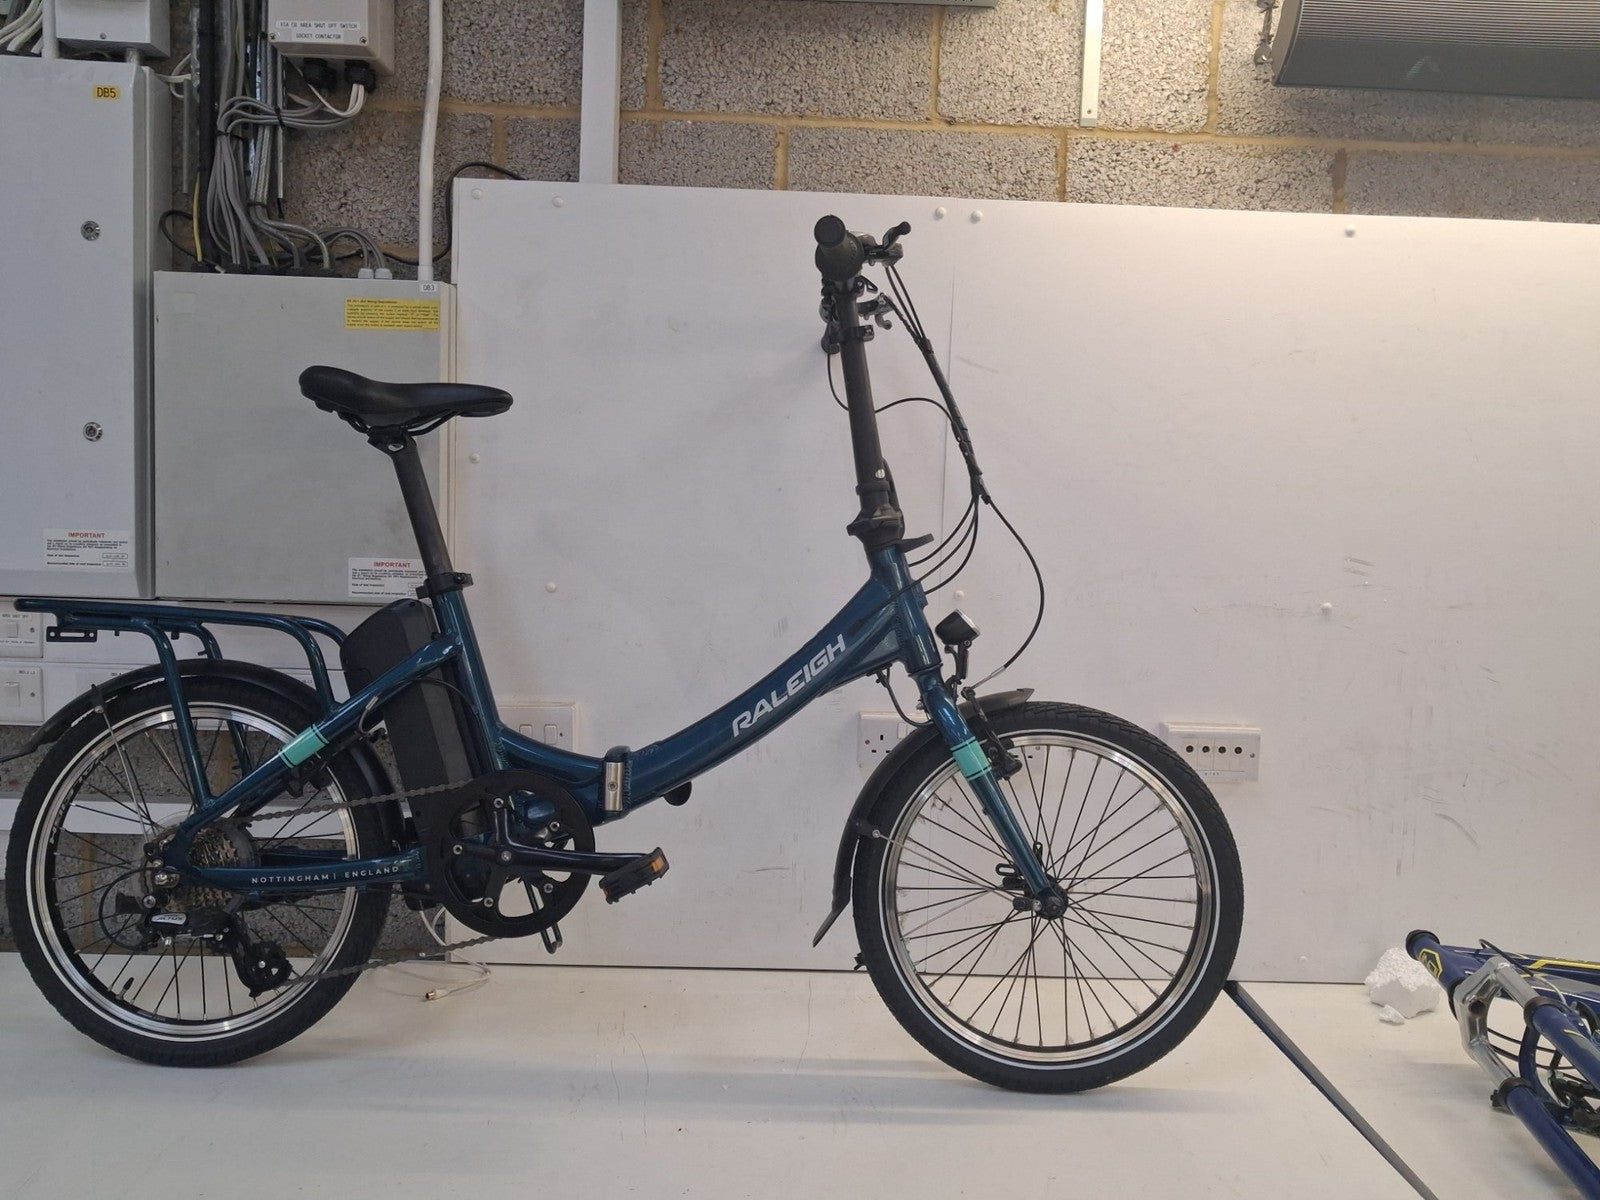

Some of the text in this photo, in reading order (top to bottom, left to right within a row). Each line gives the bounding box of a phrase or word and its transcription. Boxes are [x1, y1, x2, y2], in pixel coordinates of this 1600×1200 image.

[96, 87, 116, 98] DB5
[732, 633, 846, 738] RALEIGH
[251, 873, 329, 884] NOTTINGHAM
[344, 865, 400, 879] ENGLAND
